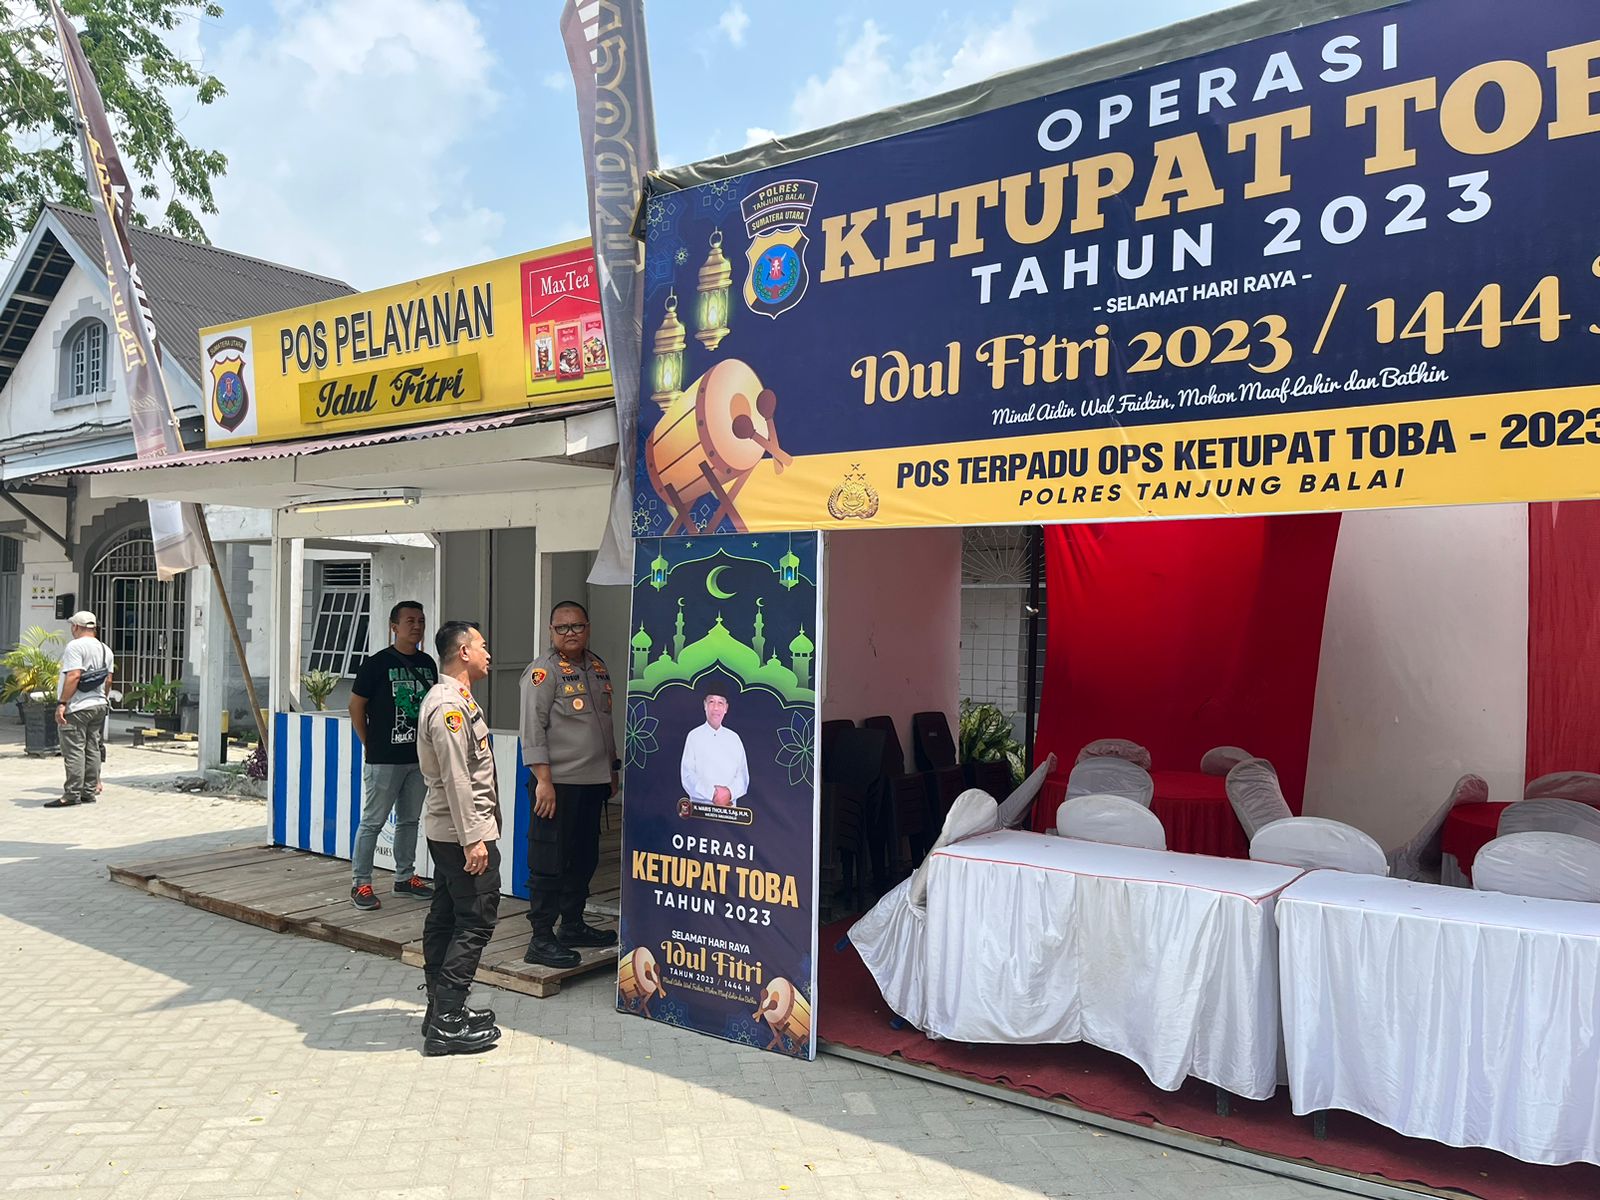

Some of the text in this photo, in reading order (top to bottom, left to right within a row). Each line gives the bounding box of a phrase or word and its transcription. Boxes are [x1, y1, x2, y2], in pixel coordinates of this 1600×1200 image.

[1037, 24, 1397, 152] OPERASI
[752, 193, 805, 210] TANJUNG BALAI
[759, 183, 799, 200] POLRES
[820, 105, 1311, 283] KETUPAT
[751, 210, 804, 230] SUMATERA UTARA
[971, 170, 1492, 304] TAHUN 2023
[540, 270, 590, 296] MaxTea
[1106, 287, 1188, 313] SELAMAT
[1193, 279, 1238, 300] HARI
[1243, 270, 1296, 293] RAYA
[280, 282, 494, 374] POS PELAYANAN
[850, 341, 961, 405] Idul
[975, 324, 1110, 390] Fitri
[1126, 314, 1293, 374] 2023
[1312, 283, 1347, 354] /
[1366, 276, 1572, 355] 1444
[316, 367, 465, 418] Idul Fitri
[991, 361, 1449, 425] Minal Aidin Wal Faidzin, Mohon Maaf Lahir dan Bathin
[897, 459, 949, 489] POS
[957, 448, 1089, 485] TERPADU
[1098, 442, 1163, 476] OPS
[1174, 429, 1336, 471] KETUPAT
[1346, 419, 1457, 460] TOBA
[1019, 468, 1404, 506] POLRES TANJUNG BALAI
[672, 834, 754, 861] OPERASI
[632, 850, 799, 908] KETUPAT TOBA
[654, 889, 771, 926] TAHUN 2023
[661, 940, 762, 985] Idul Fitri
[672, 930, 751, 954] SELAMAT HARI RAYA
[670, 967, 693, 978] TAHUN
[696, 973, 714, 984] 2023
[724, 980, 742, 991] 1444
